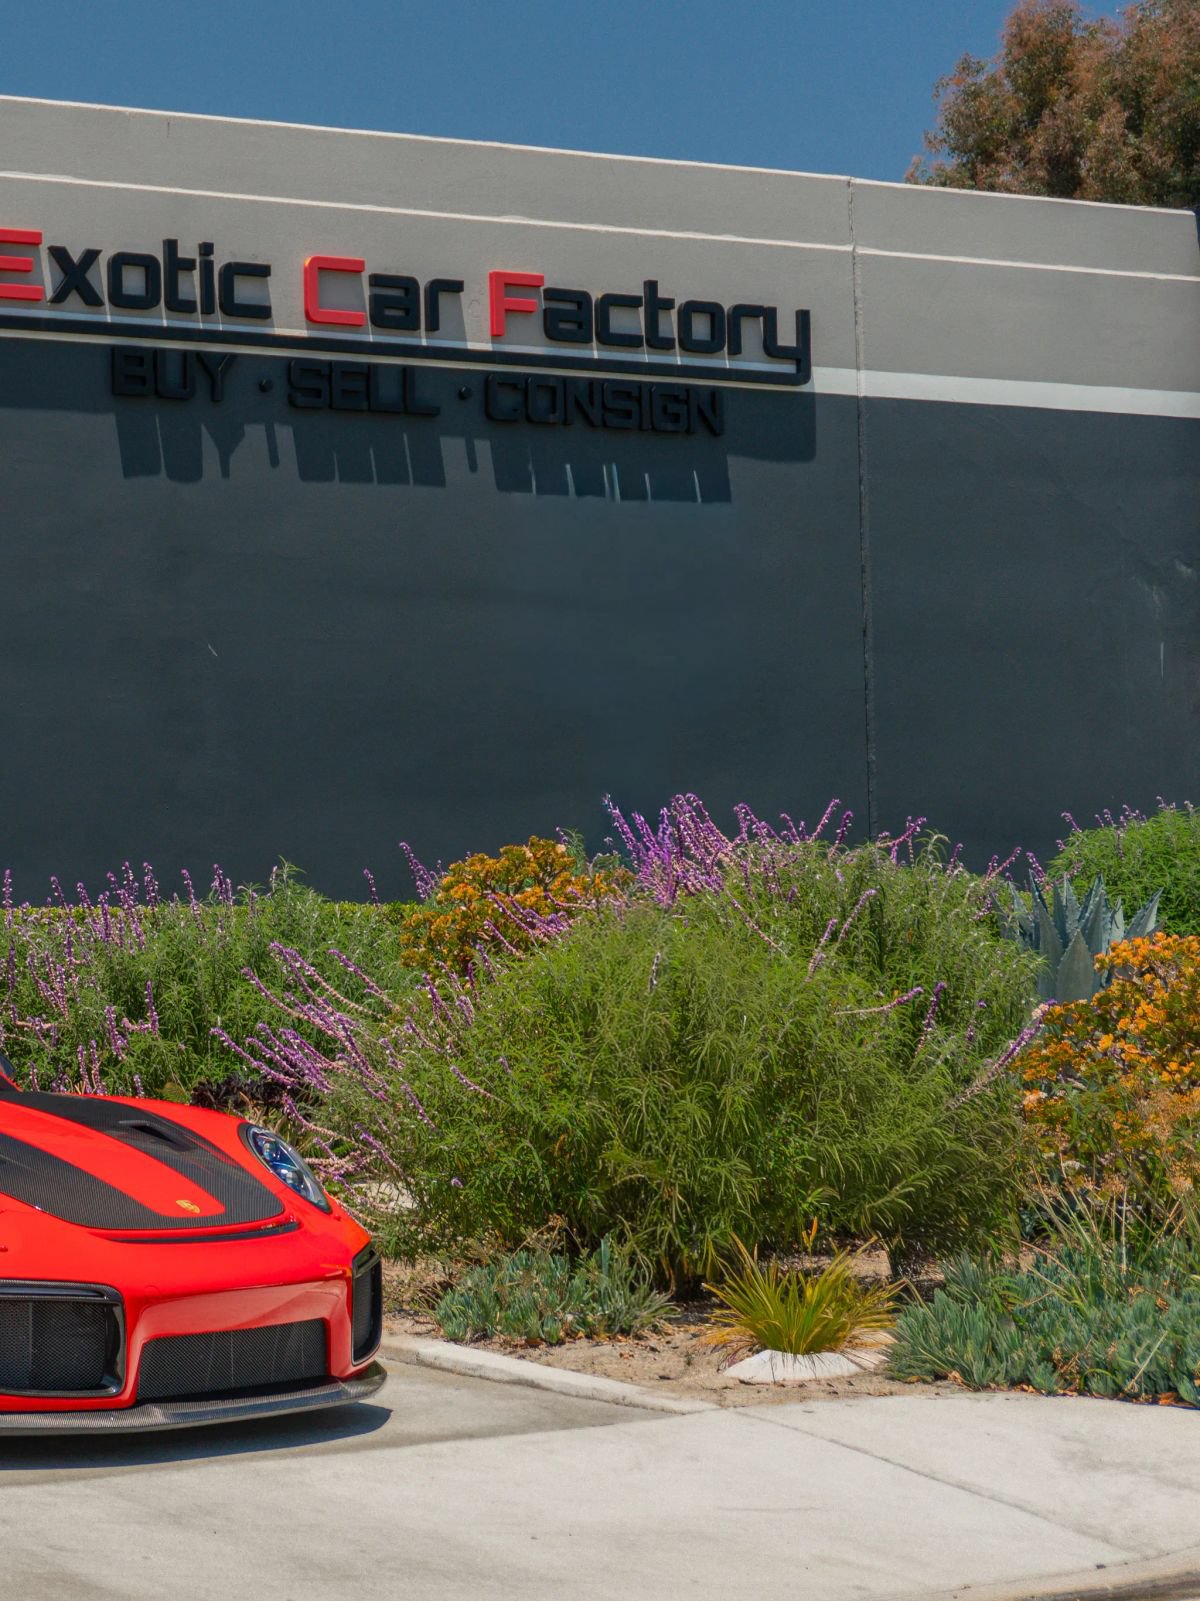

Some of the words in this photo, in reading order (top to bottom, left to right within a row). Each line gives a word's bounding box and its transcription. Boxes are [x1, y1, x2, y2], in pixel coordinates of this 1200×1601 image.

[304, 256, 464, 331] Car
[489, 270, 812, 385] Factory
[112, 345, 237, 402] BUY
[288, 359, 440, 416] SELL
[485, 373, 725, 436] CONSIGN
